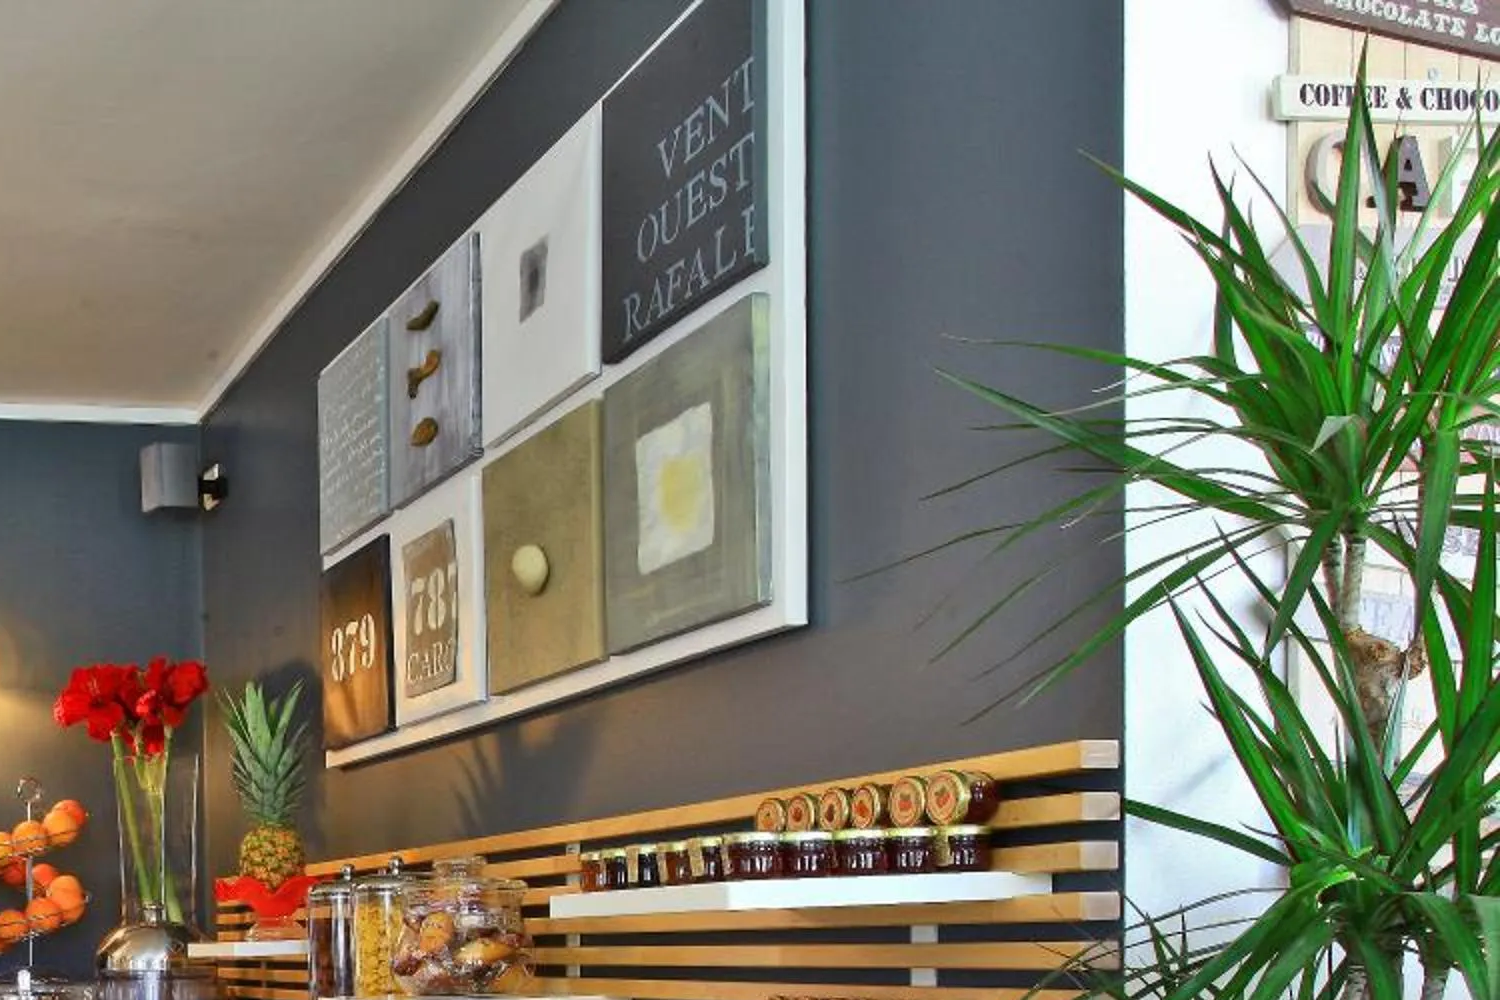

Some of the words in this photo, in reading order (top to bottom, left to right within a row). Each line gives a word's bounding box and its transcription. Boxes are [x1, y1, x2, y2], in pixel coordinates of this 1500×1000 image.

[657, 57, 755, 177] VENT
[1395, 86, 1413, 110] &
[636, 132, 755, 263] OUEST
[331, 612, 376, 683] 879
